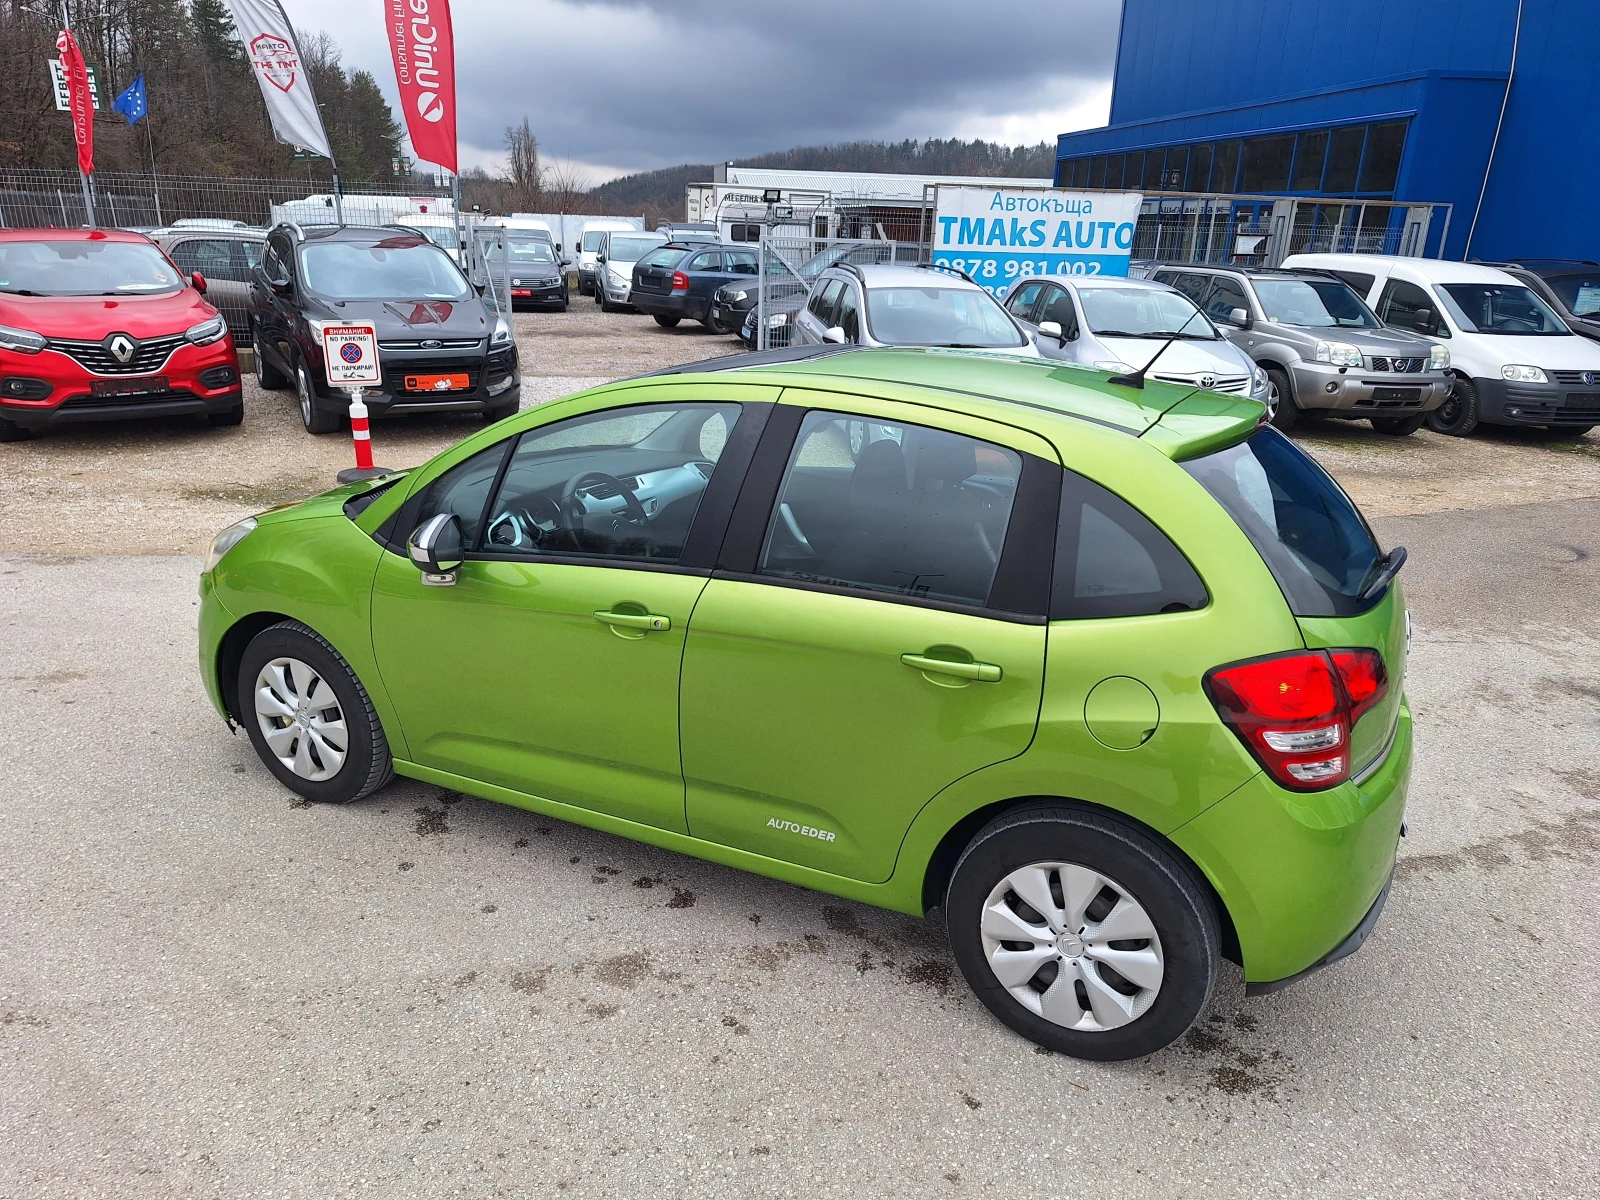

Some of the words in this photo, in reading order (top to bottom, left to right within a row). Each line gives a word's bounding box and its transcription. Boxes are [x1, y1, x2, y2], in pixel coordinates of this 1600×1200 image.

[253, 61, 273, 69] THE
[276, 59, 298, 69] TINT
[75, 83, 87, 145] Consumer
[990, 191, 1093, 217] Автокъща
[938, 216, 1047, 248] TMAkS
[1052, 220, 1134, 250] AUTO
[1004, 260, 1048, 278] 981
[766, 817, 801, 833] AUTO
[801, 825, 836, 842] EDER
